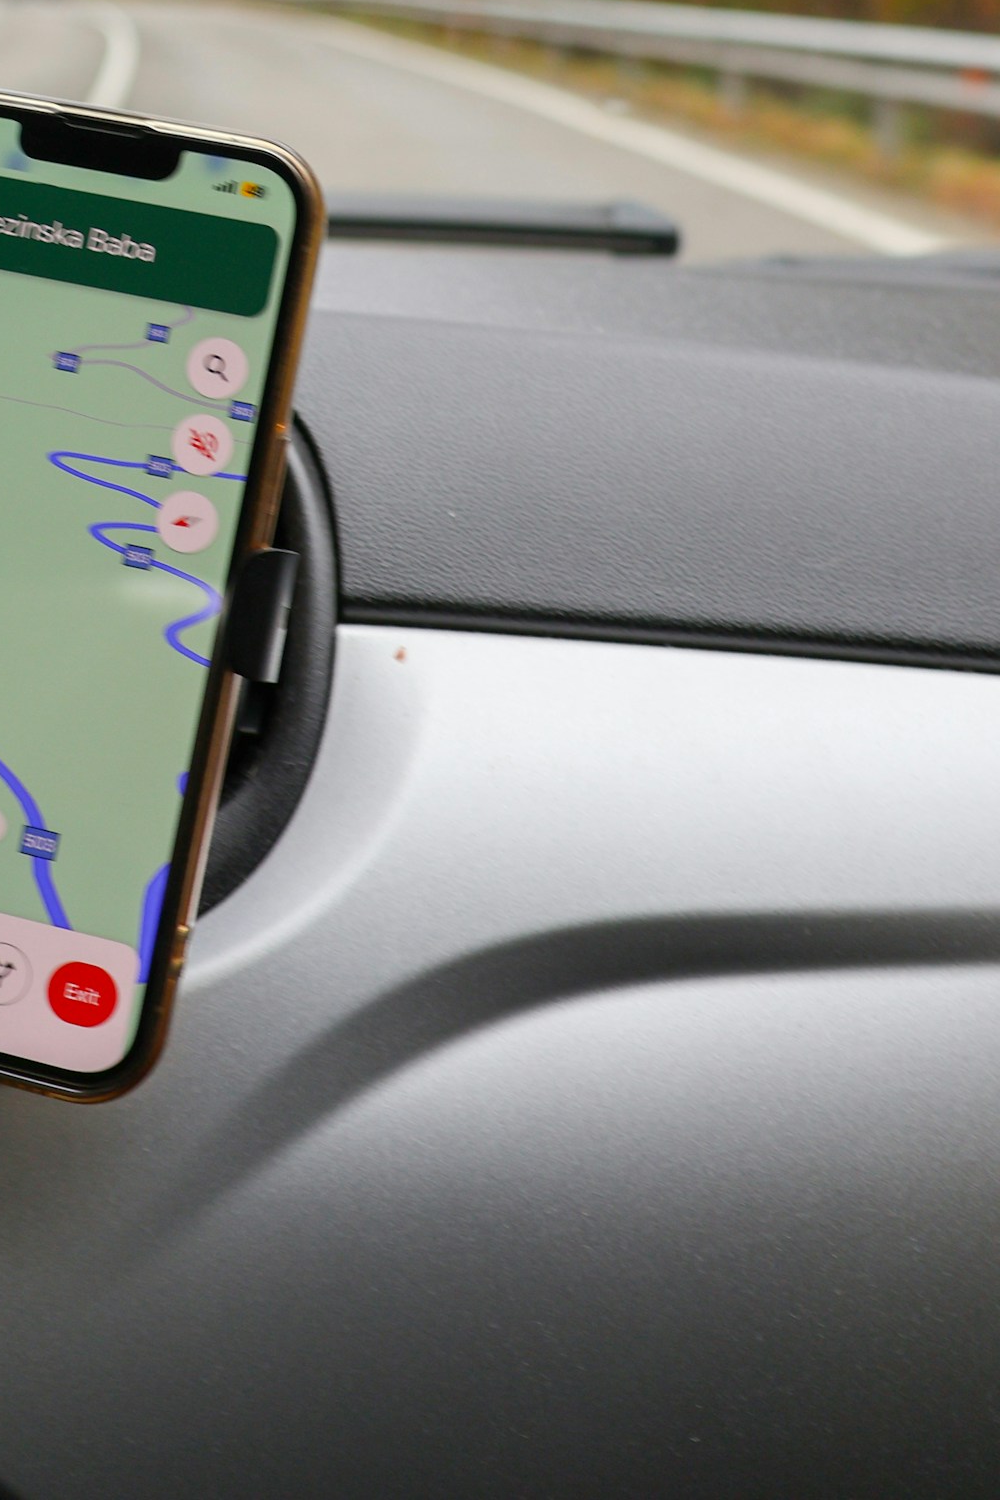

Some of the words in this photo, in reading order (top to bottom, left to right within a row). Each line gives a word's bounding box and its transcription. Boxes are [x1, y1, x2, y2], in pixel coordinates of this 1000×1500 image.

[86, 227, 157, 263] Baba
[23, 832, 58, 854] 503
[63, 982, 101, 1007] Exit
